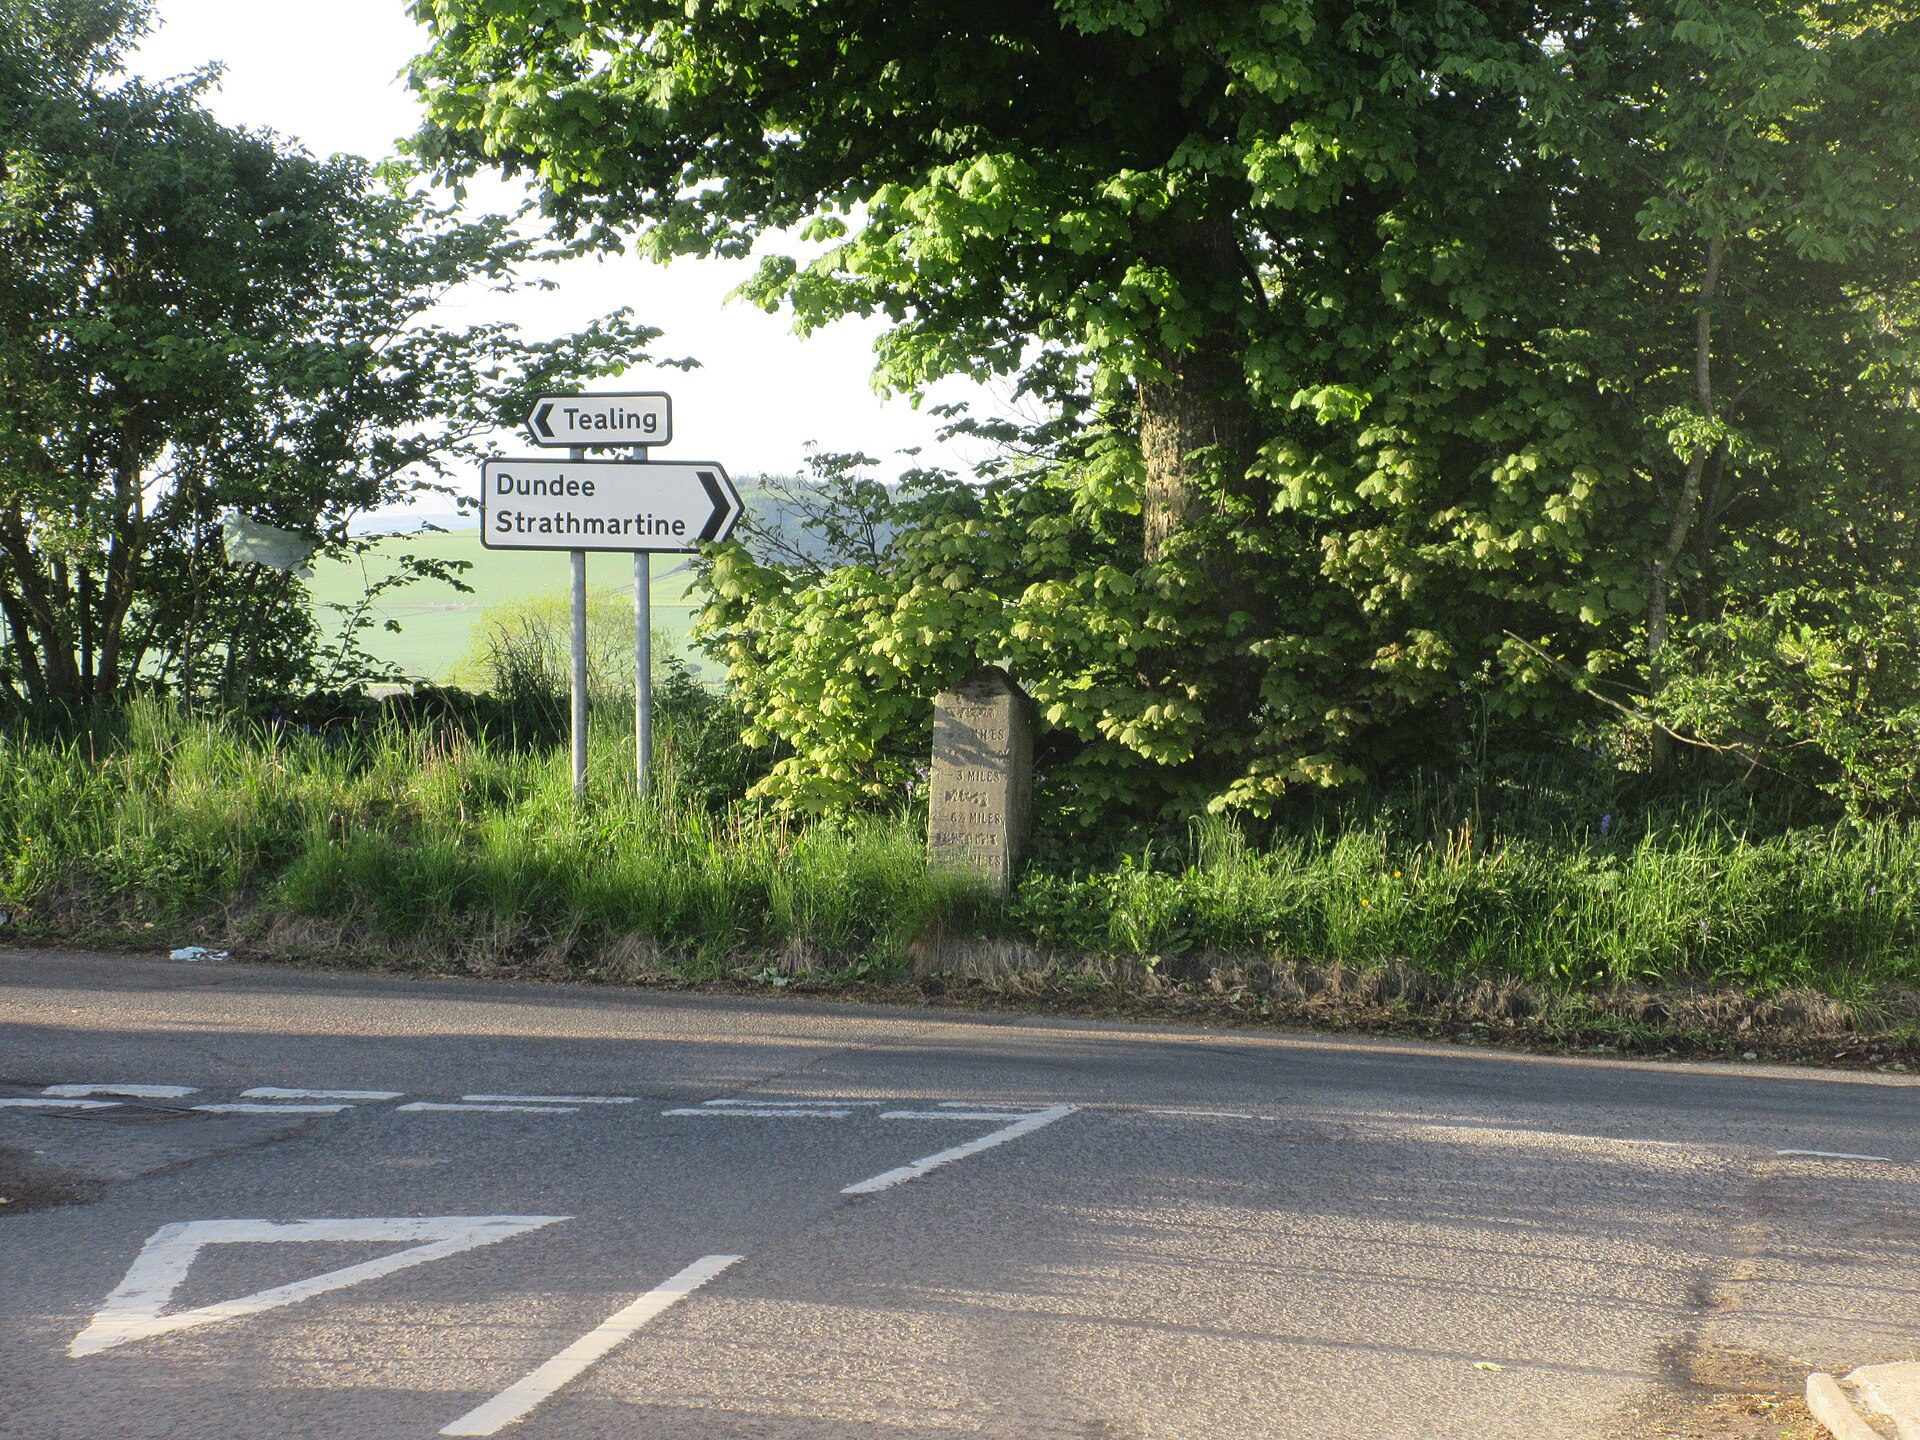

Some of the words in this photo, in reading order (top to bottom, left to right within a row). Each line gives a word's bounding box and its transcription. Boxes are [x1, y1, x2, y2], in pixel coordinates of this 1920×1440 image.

[563, 407, 657, 434] Tealing
[496, 473, 595, 497] Dundee
[495, 510, 686, 536] Strathmartine
[956, 770, 963, 782] 3
[967, 770, 1001, 783] MILES
[969, 812, 1002, 825] MILES
